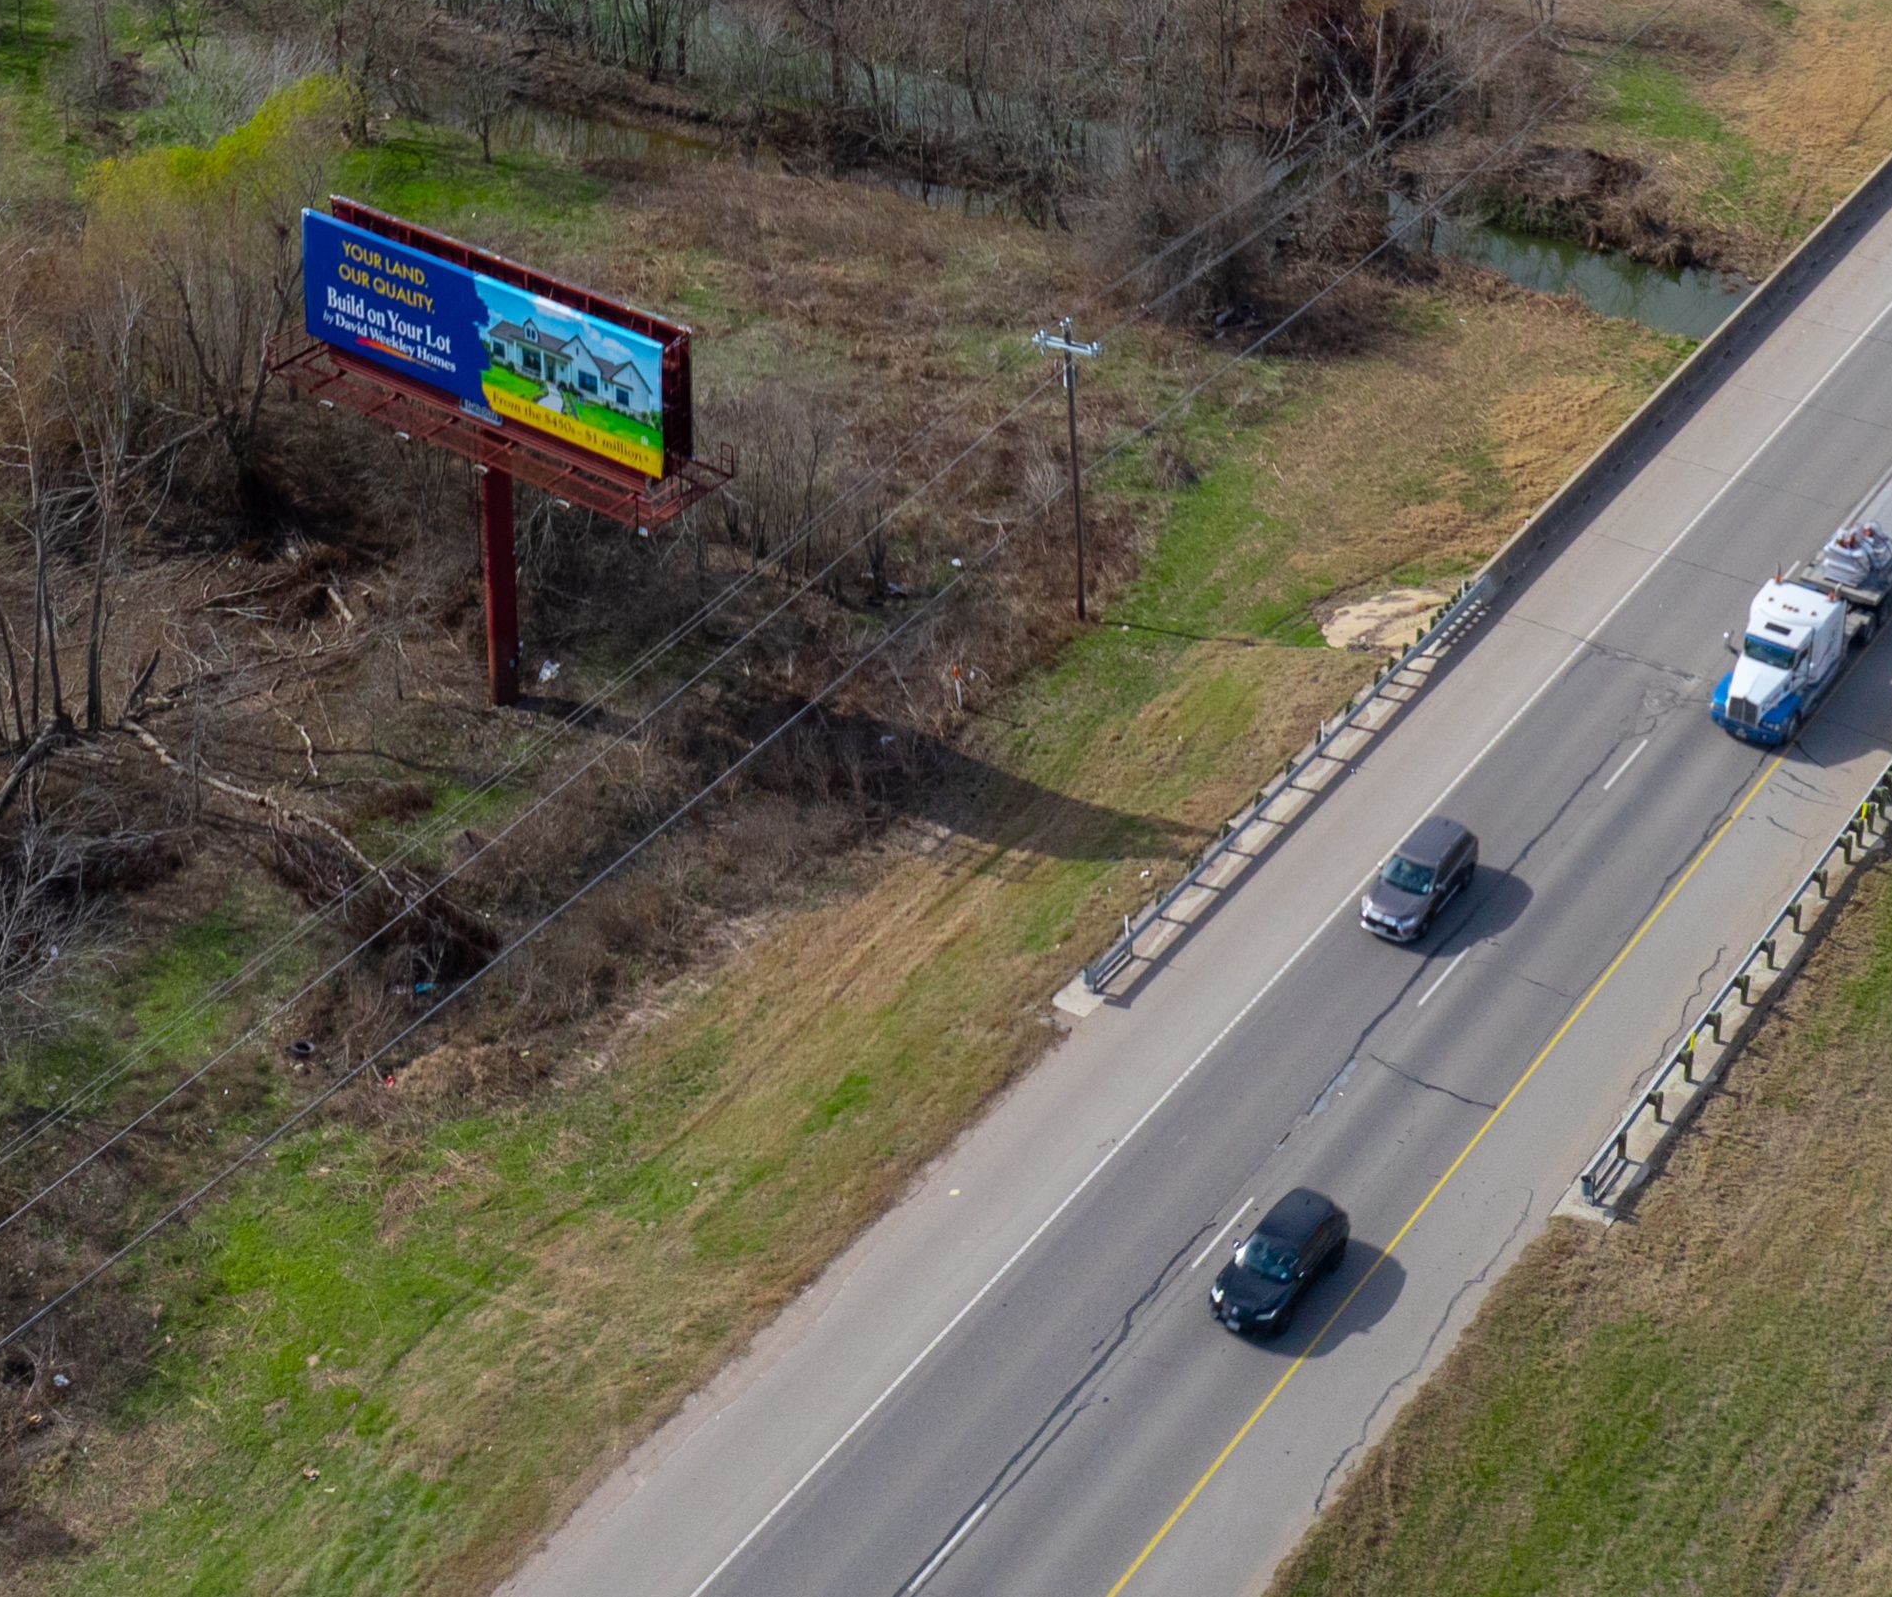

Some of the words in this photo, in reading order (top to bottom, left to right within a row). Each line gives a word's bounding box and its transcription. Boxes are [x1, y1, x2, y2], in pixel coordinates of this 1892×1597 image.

[338, 263, 370, 289] OUR
[342, 240, 382, 270] YOUR
[385, 257, 429, 288] LAND,
[323, 309, 335, 325] by
[335, 312, 368, 337] David
[369, 325, 415, 357] Weekley
[417, 345, 456, 373] Homes
[327, 285, 365, 320] Build
[367, 308, 386, 329] on
[387, 309, 423, 342] Your
[425, 324, 451, 354] Lot
[493, 390, 521, 414] From
[524, 404, 542, 421] the
